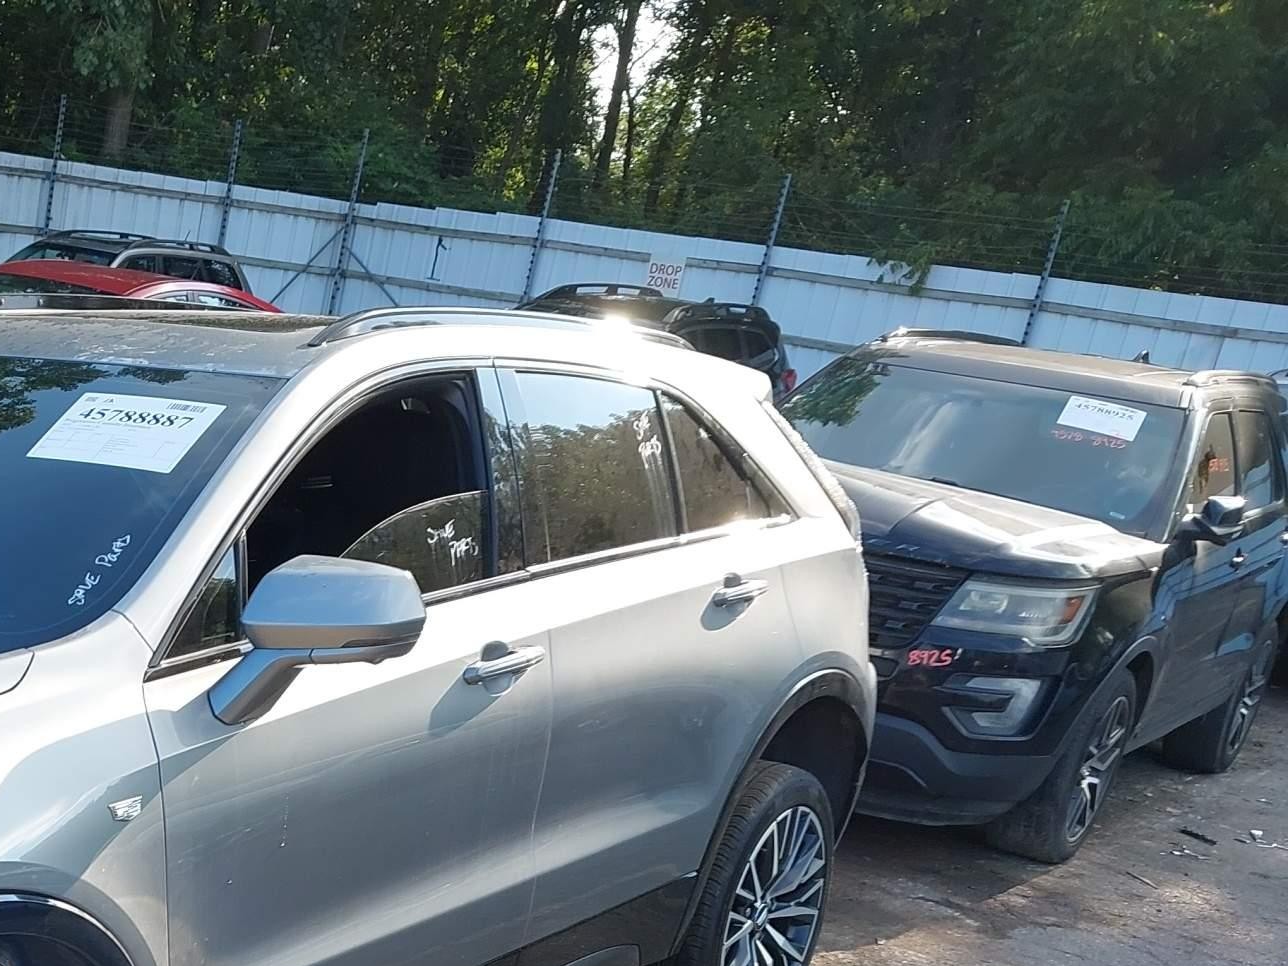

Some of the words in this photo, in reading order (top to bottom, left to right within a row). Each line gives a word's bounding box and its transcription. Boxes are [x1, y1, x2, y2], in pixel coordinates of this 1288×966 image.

[649, 262, 682, 276] DROP
[647, 275, 679, 289] ZONE
[79, 407, 194, 429] 45788887
[907, 648, 953, 667] 8925
